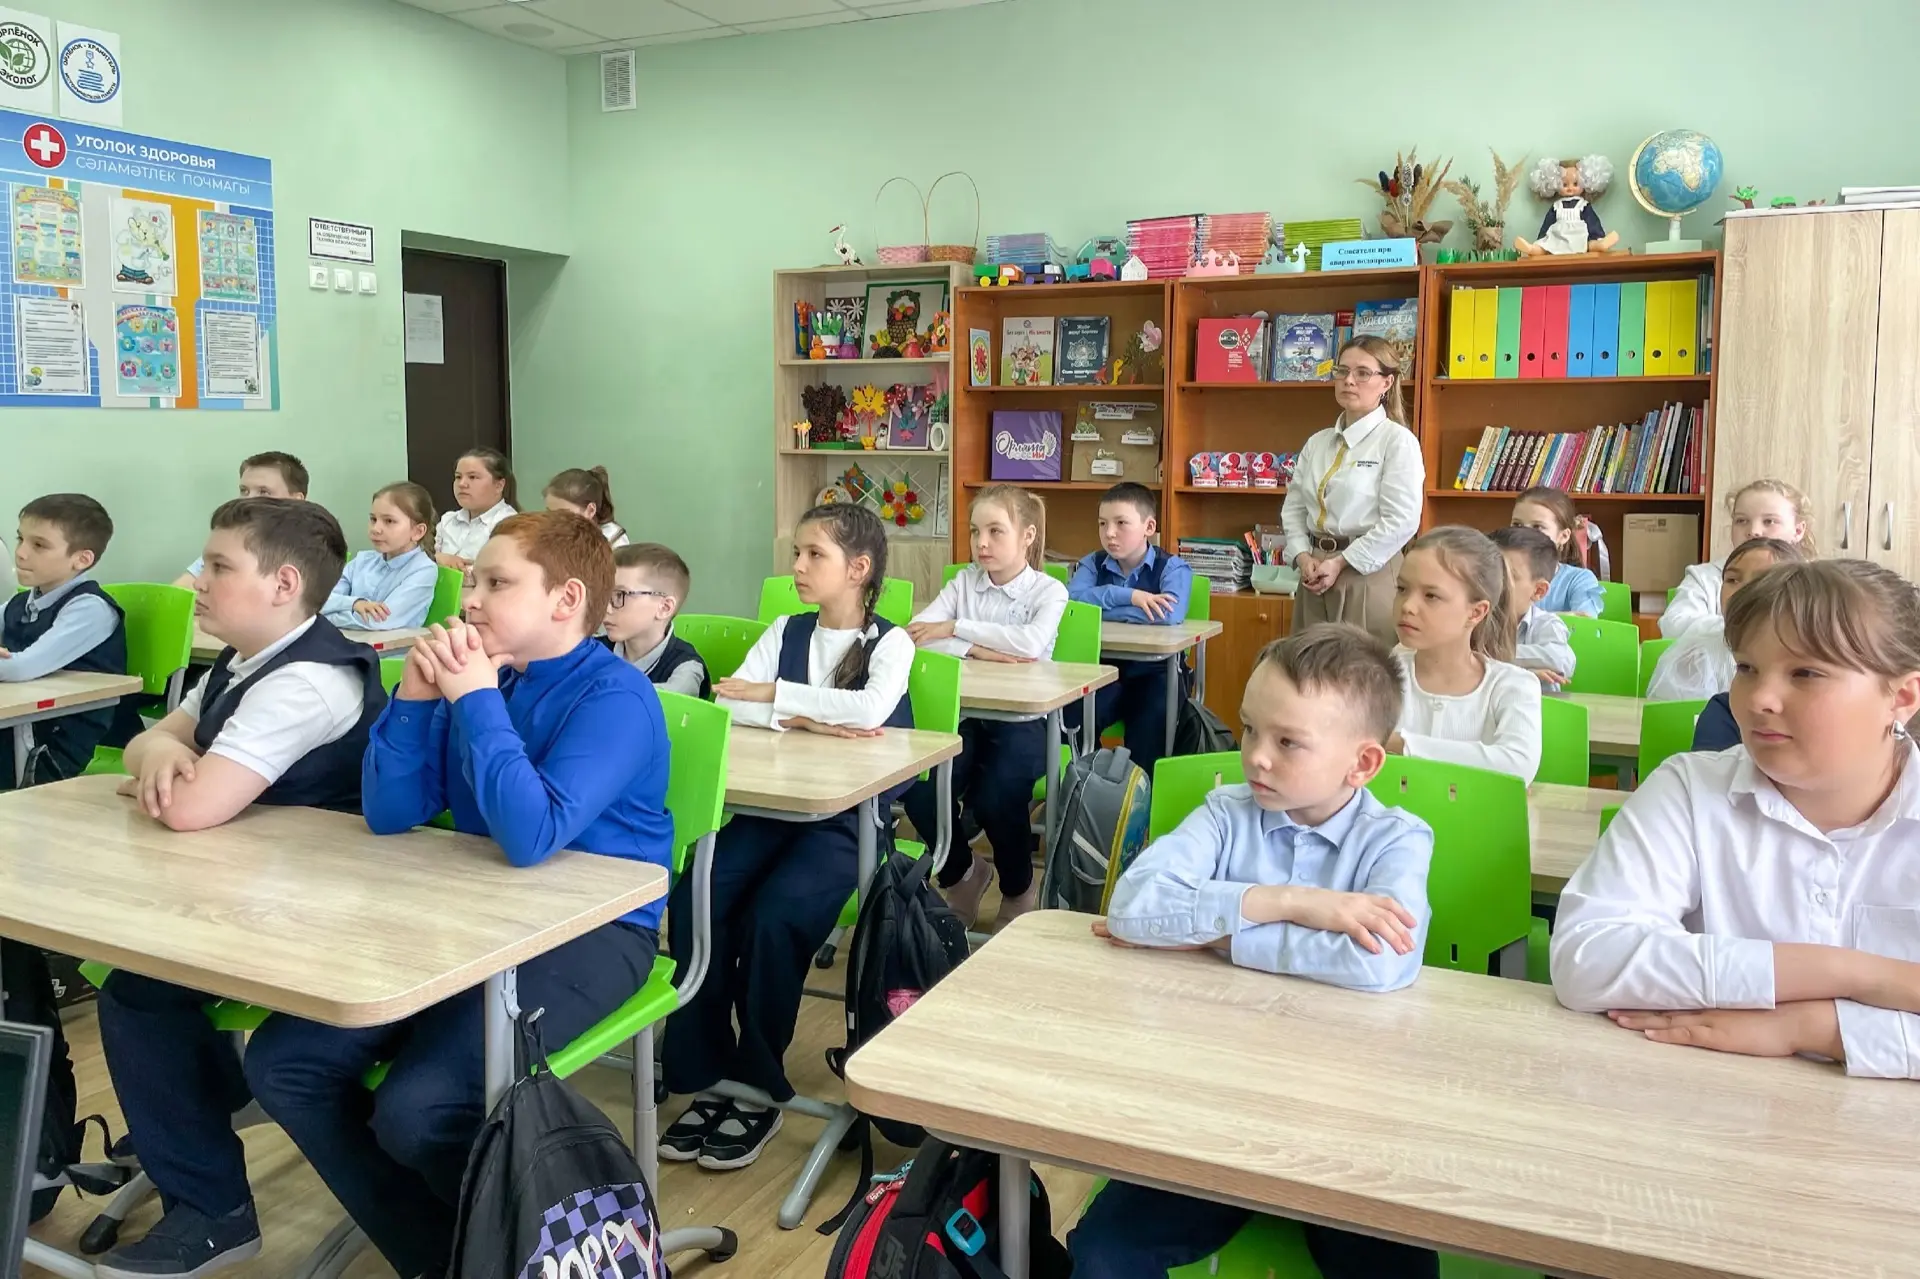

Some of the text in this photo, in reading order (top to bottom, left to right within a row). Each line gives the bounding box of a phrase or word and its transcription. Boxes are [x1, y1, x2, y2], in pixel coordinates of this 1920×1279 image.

[88, 43, 117, 75] ХРАНИТЕЛЬ
[0, 69, 37, 85] ЭКОЛОГ
[75, 134, 216, 170] УГОЛОК ЗДОРОВЬЯ
[76, 156, 250, 195] СӘЛАМӘТЛЕК ПОЧМАГЫ
[315, 222, 367, 236] ОТВЕТСТВЕННЫЙ
[335, 239, 367, 247] БЕЗОПАСНОСТИ
[1377, 246, 1392, 254] при
[1329, 257, 1403, 267] аварии водопровода
[997, 432, 1046, 455] Орлята
[1228, 452, 1240, 469] 9
[1261, 452, 1274, 469] 9
